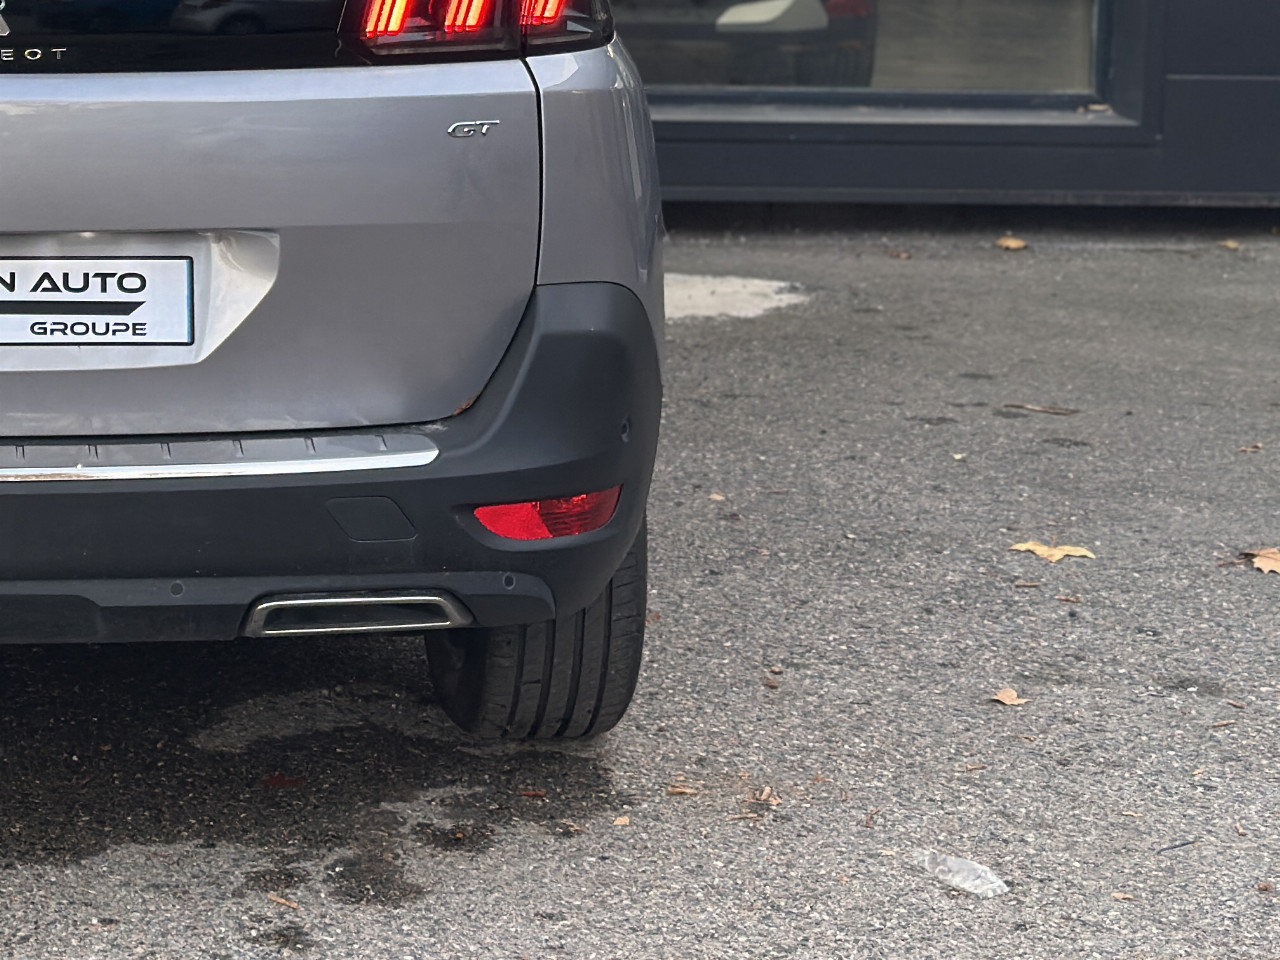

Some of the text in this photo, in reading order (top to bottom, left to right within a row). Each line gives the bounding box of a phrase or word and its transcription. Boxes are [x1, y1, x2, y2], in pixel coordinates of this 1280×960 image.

[447, 119, 501, 138] GT
[29, 271, 147, 294] AUTO
[29, 321, 148, 337] GROUPE
